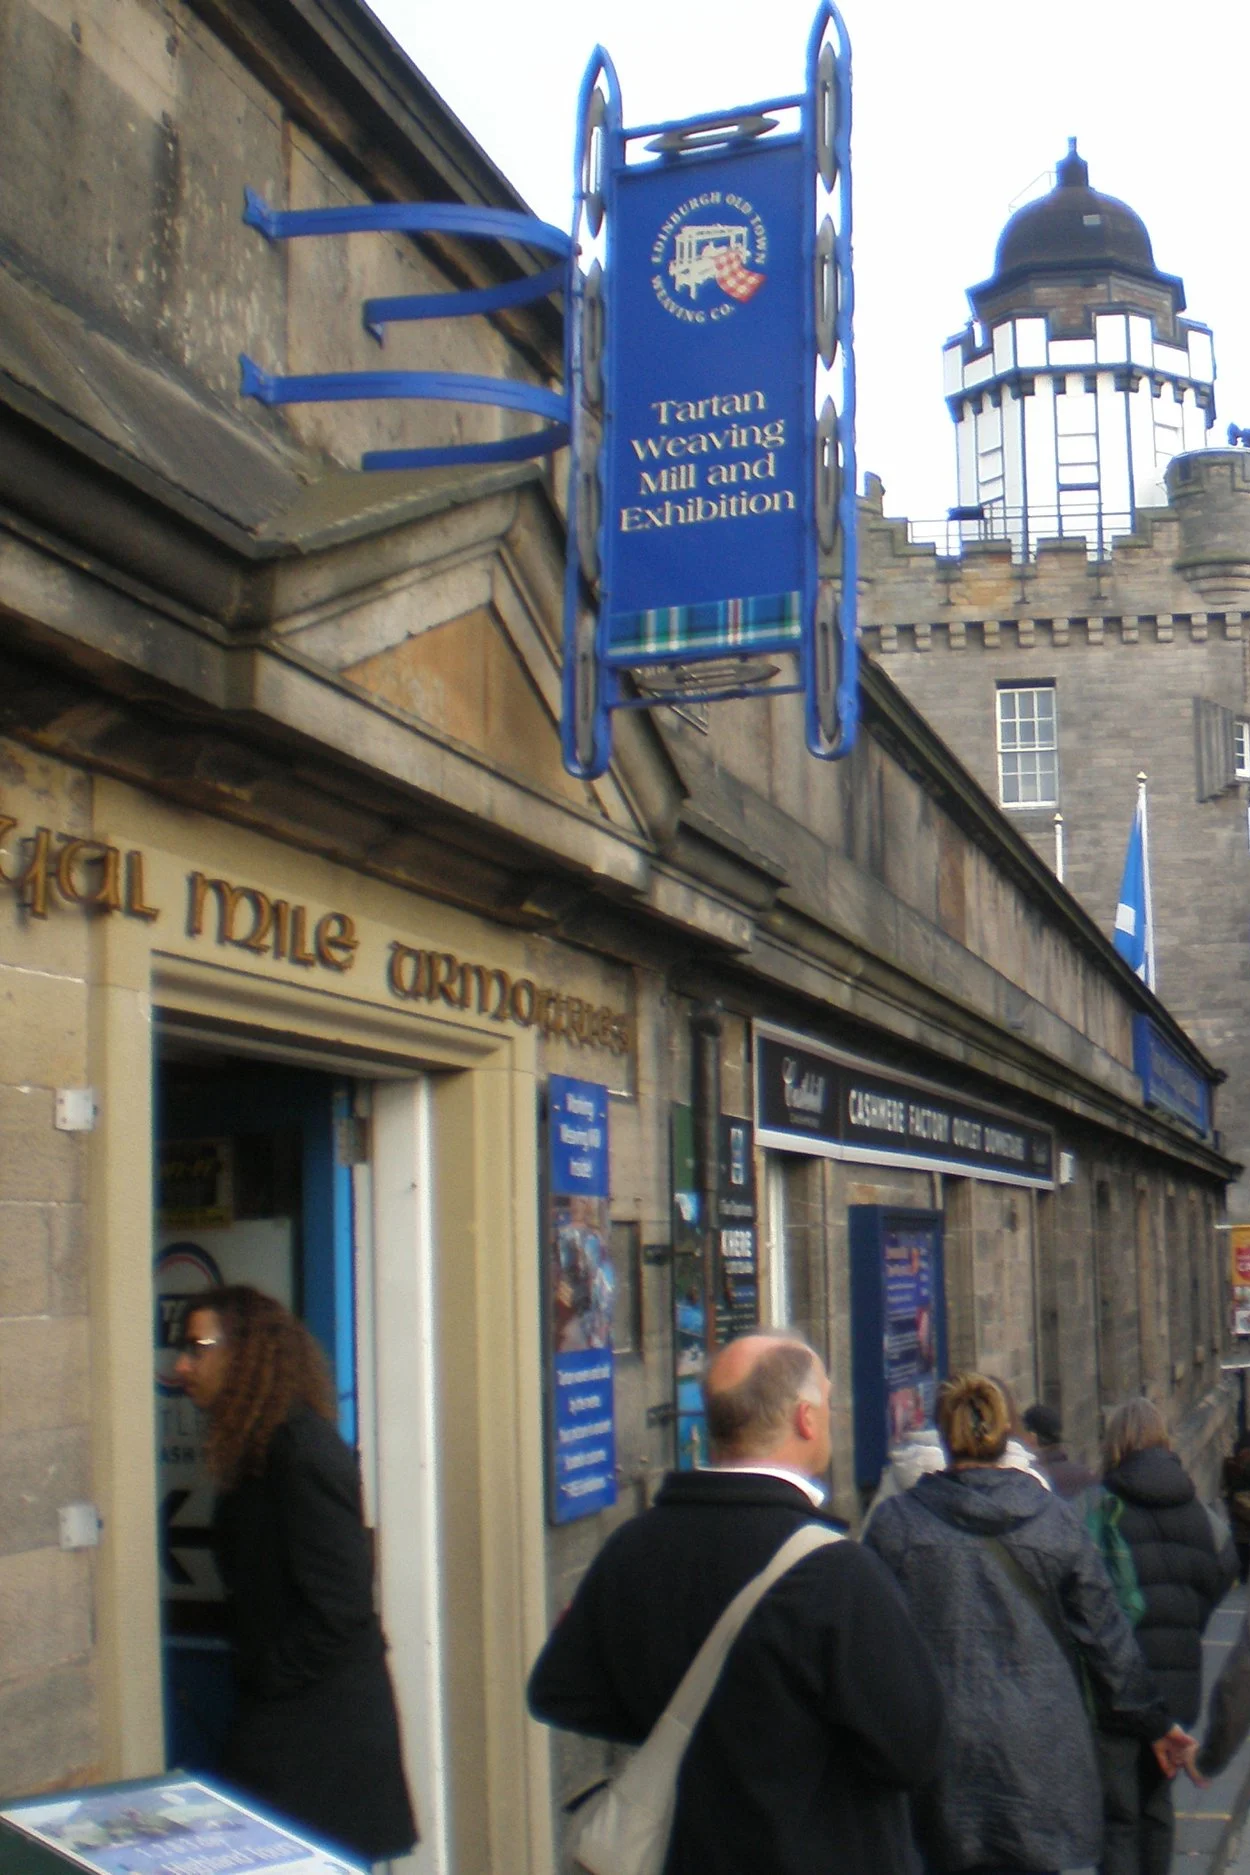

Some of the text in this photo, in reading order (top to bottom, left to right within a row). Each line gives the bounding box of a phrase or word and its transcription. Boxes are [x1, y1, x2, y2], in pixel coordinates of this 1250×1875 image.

[651, 191, 767, 264] EDINBURGH OLD TOWN
[651, 275, 706, 323] WEAVING
[651, 390, 767, 425] Tartan
[630, 418, 785, 462] Weaving
[639, 451, 776, 496] Mill and
[619, 489, 796, 532] Exhibition
[848, 1088, 905, 1134] CASHMERE
[908, 1104, 950, 1143] FACTORY
